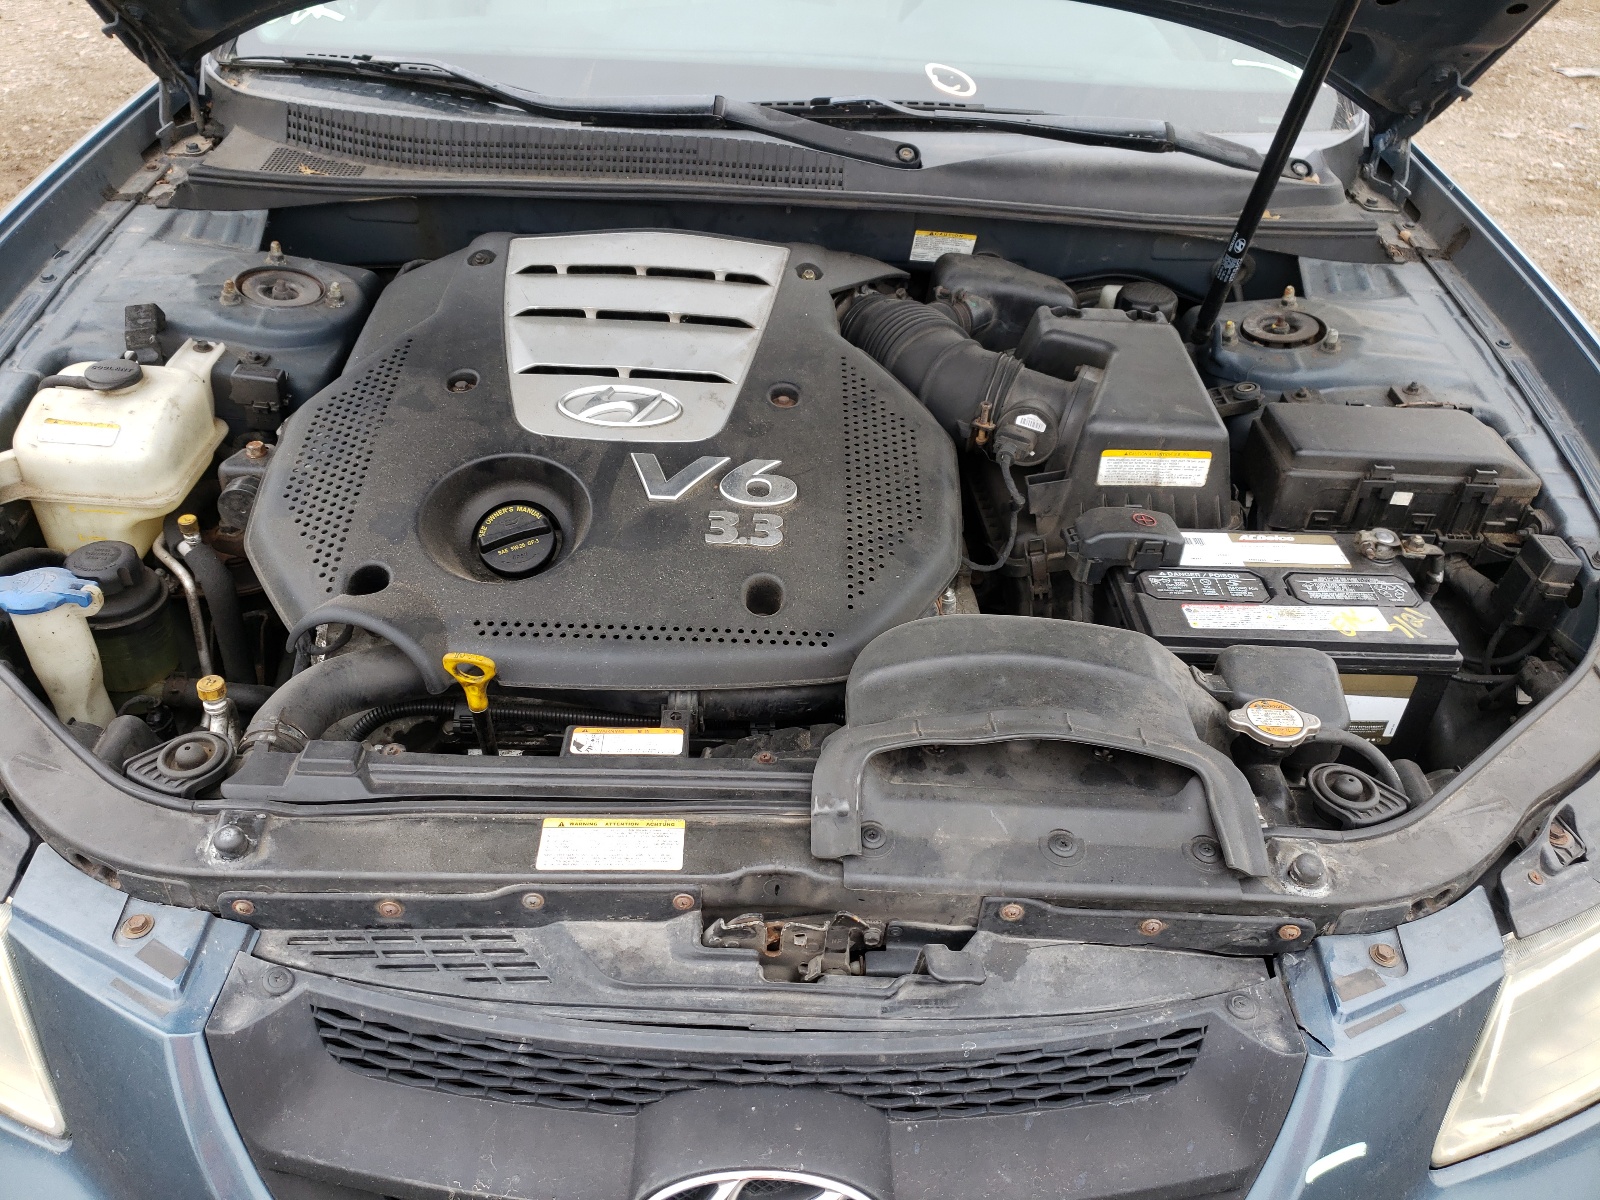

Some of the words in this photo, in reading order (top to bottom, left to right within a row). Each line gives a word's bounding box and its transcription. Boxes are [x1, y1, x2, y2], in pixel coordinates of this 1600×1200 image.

[91, 365, 134, 373] COOLANT
[630, 452, 798, 507] V6
[478, 525, 488, 538] SEE
[485, 506, 514, 525] OWNER'S
[516, 506, 543, 520] MANUAL
[704, 510, 784, 547] 3.3
[1239, 534, 1295, 542] ACDelco
[497, 547, 509, 556] SAE
